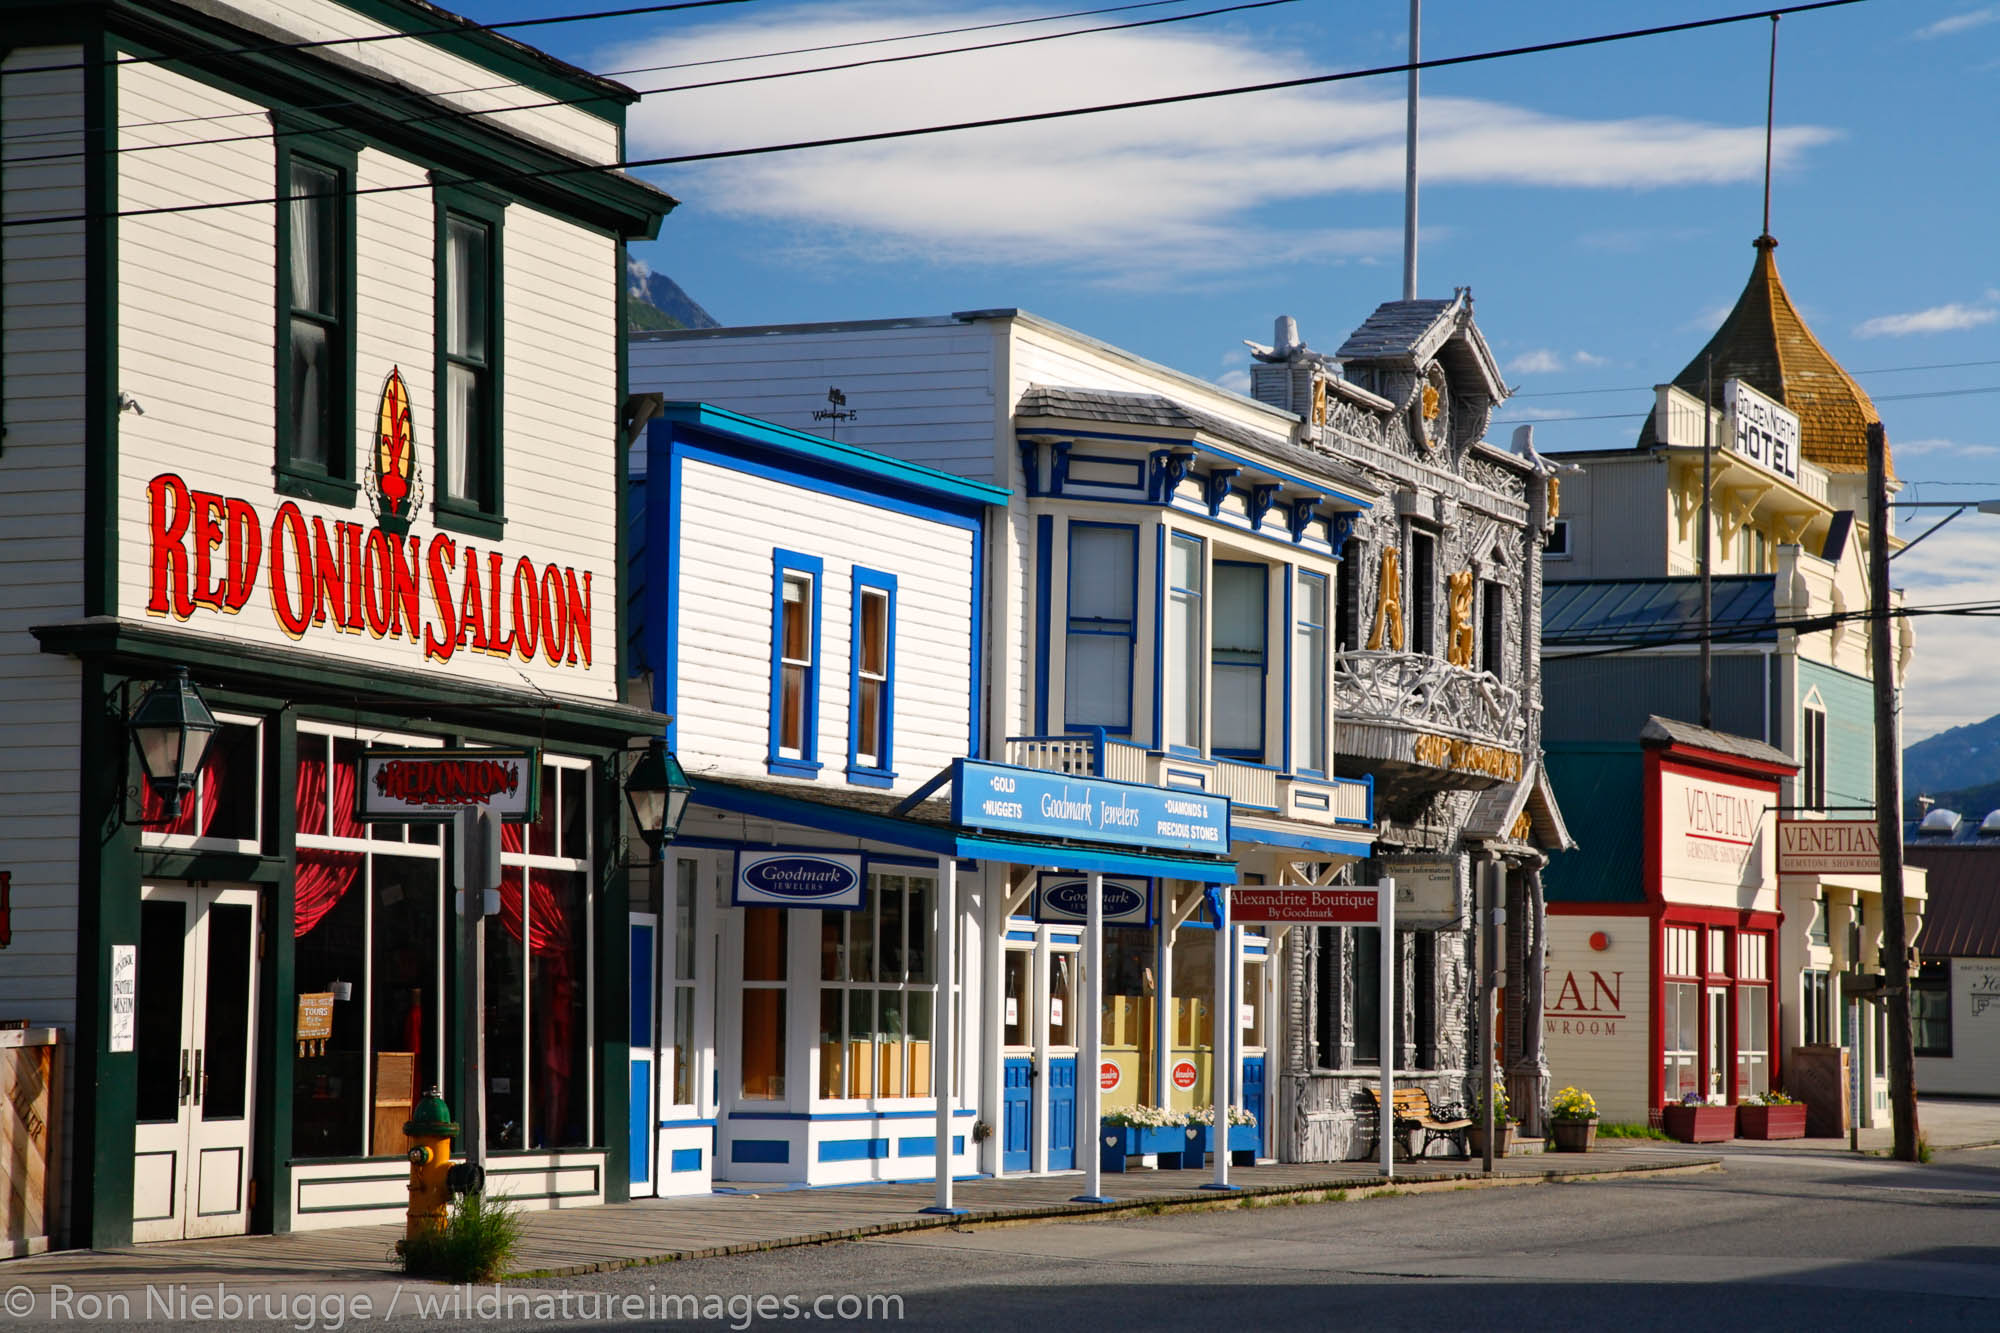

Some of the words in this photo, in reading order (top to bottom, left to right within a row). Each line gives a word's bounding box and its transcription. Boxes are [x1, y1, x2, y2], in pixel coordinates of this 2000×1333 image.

[1736, 417, 1795, 479] HOTEL
[146, 473, 262, 622] RED
[269, 501, 421, 644] ONION
[423, 533, 592, 670] SALOON
[384, 760, 432, 800] RED
[432, 760, 509, 797] ONION
[985, 799, 1023, 819] NUGGETS
[1041, 785, 1092, 826] Goodmark
[1099, 791, 1139, 830] Jewelers
[1203, 808, 1209, 819] &
[1685, 787, 1754, 840] VENETIAN
[1157, 820, 1190, 839] PRECIOUS
[1190, 824, 1219, 842] STONES
[1784, 827, 1880, 853] VENETIAN
[1412, 866, 1451, 874] Information
[1784, 858, 1828, 868] GEMSTONE
[1832, 858, 1880, 868] SHOWROOM
[761, 866, 841, 882] Goodmark
[773, 882, 824, 891] JEWELERS
[1230, 891, 1307, 906] Alexandrite
[1312, 892, 1375, 908] Boutique
[1268, 907, 1281, 919] By
[1282, 907, 1334, 919] Goodmark
[304, 1007, 329, 1017] TOURS
